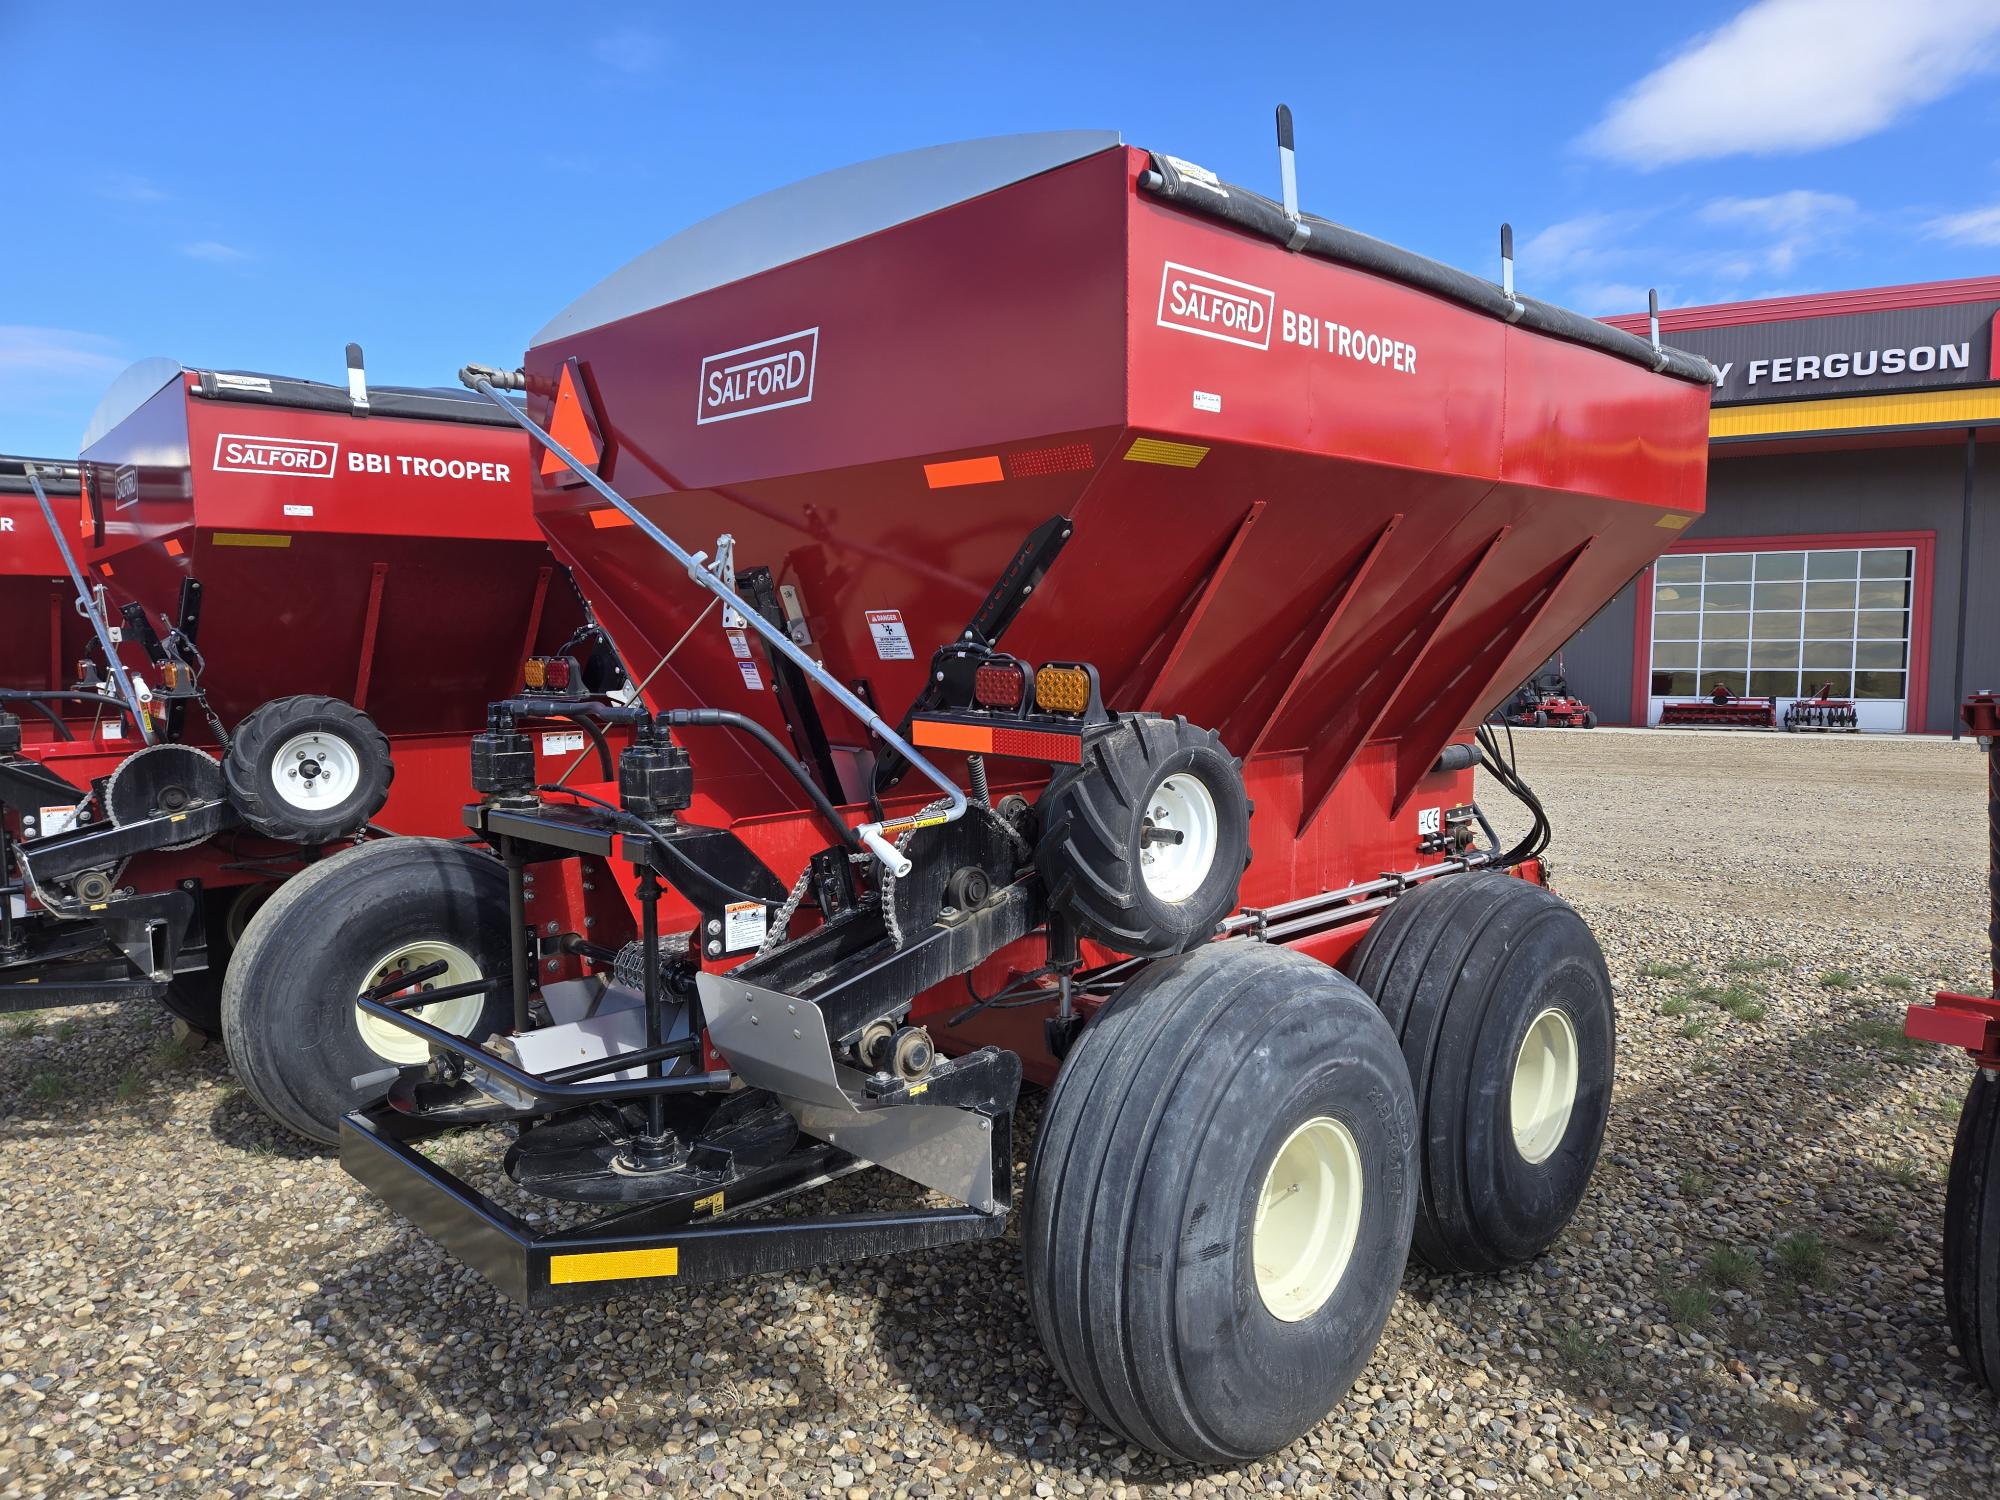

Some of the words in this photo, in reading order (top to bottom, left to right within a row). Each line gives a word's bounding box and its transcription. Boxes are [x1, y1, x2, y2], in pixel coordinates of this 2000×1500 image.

[1170, 280, 1264, 334] SALFORD
[1282, 309, 1319, 349] BBI
[1325, 320, 1417, 374] TROOPER
[707, 350, 806, 407] SALFORD
[1748, 342, 1970, 385] FERGUSON
[225, 443, 328, 469] SALFORD
[348, 452, 391, 474] BBI
[397, 455, 511, 482] TROOPER
